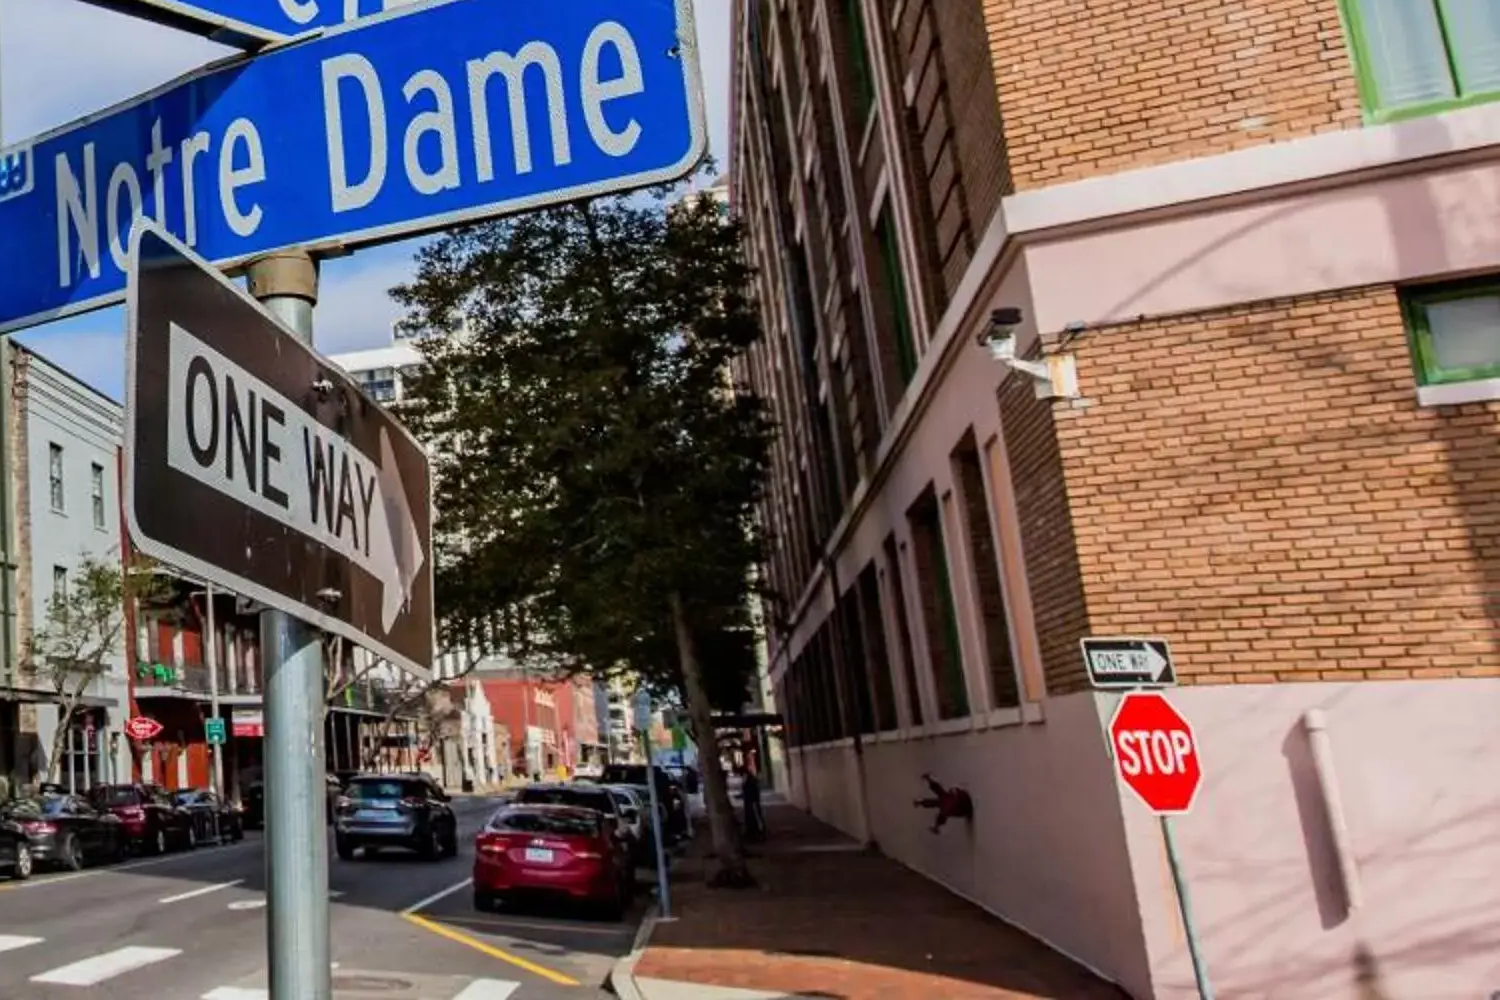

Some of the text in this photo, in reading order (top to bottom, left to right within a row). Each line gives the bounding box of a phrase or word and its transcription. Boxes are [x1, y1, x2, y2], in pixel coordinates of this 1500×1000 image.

[55, 20, 645, 287] Notre Dame
[185, 355, 376, 558] ONE WAY
[1096, 653, 1126, 670] ONE
[1117, 729, 1191, 775] STOP
